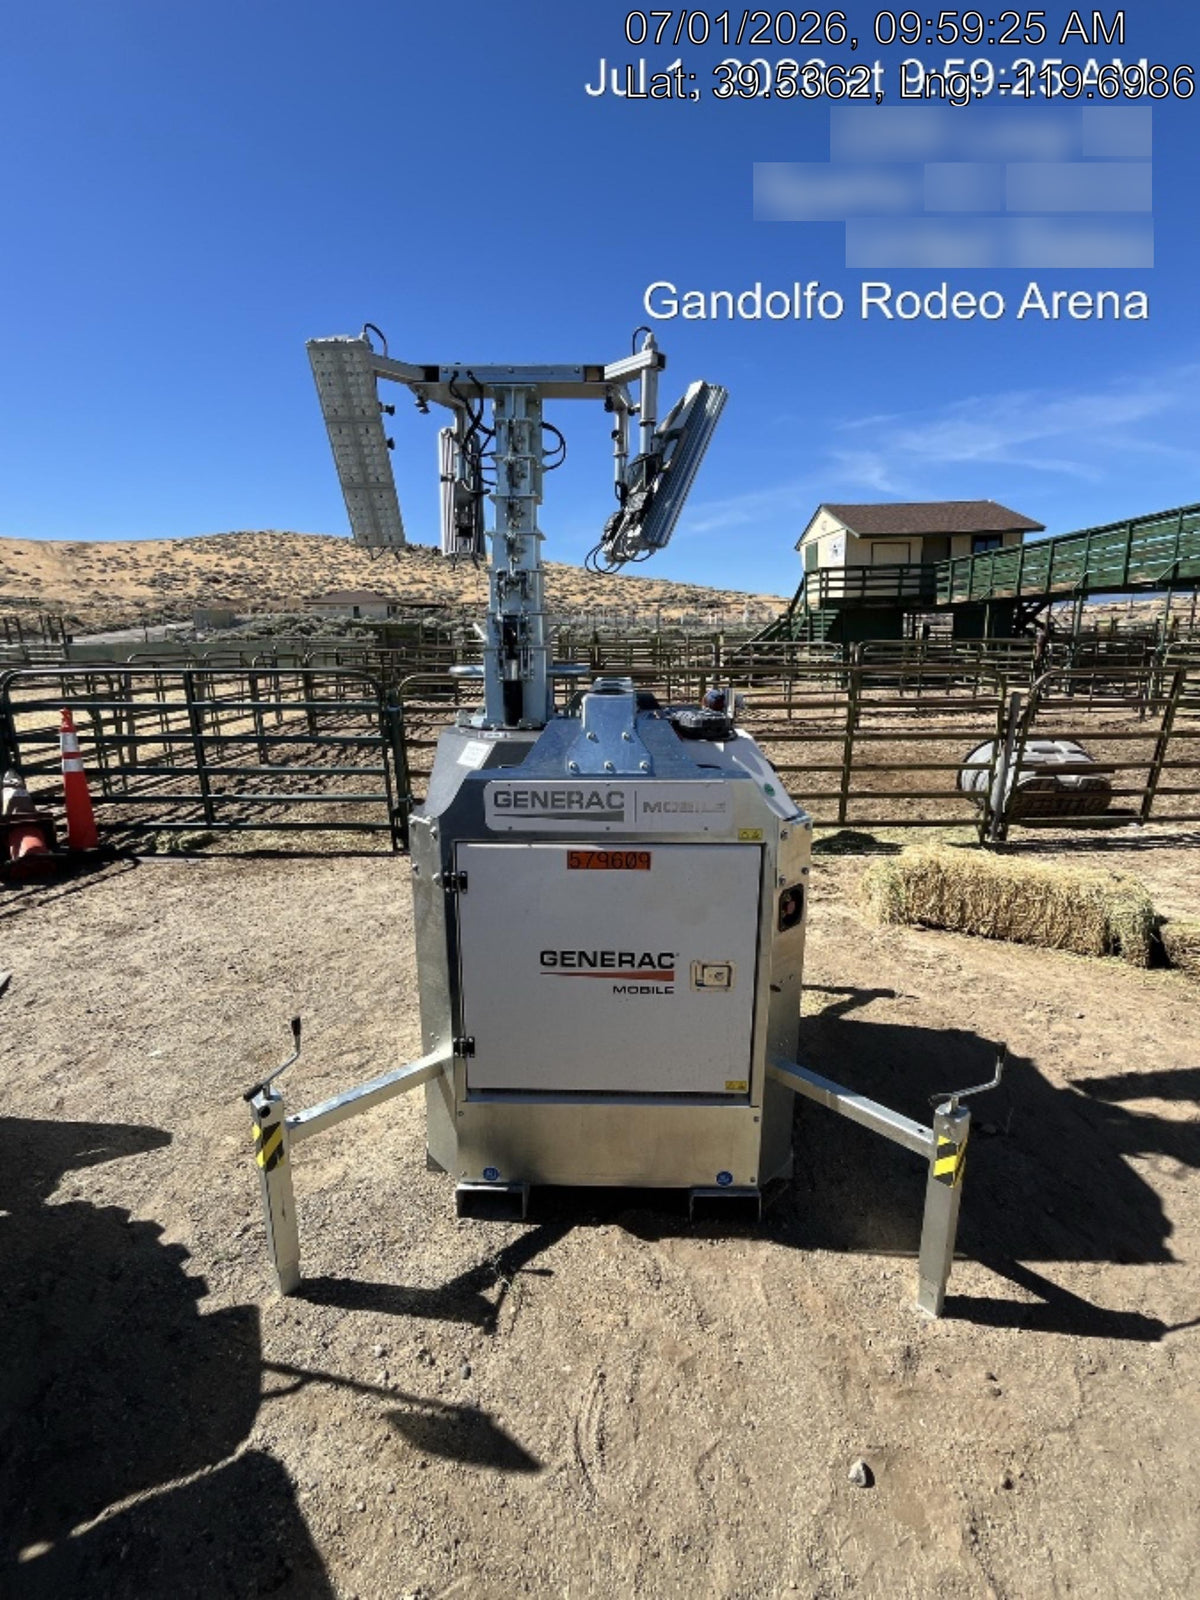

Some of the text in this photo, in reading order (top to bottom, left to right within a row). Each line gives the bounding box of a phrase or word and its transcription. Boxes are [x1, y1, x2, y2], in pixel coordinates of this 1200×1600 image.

[493, 790, 624, 810] GENERAC
[568, 851, 651, 869] 579609
[539, 950, 675, 969] GENERAC
[612, 985, 674, 995] MOBILE
